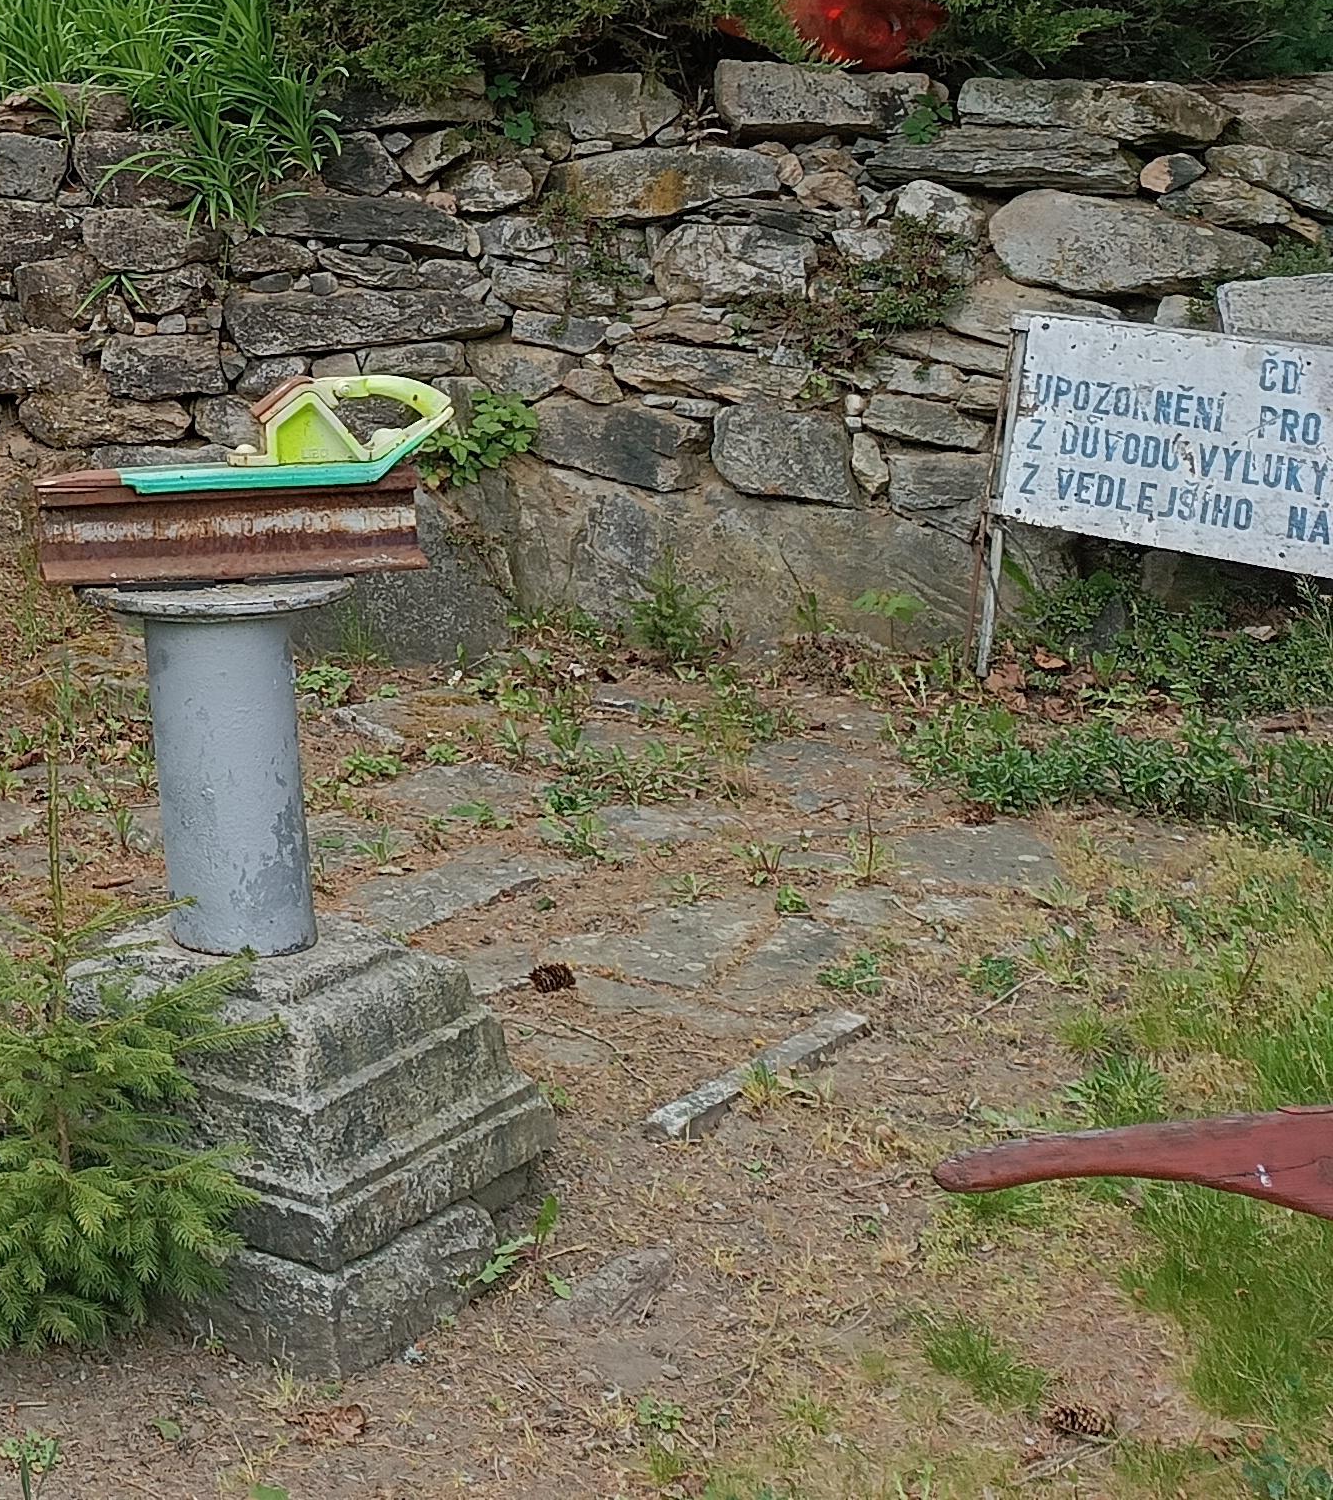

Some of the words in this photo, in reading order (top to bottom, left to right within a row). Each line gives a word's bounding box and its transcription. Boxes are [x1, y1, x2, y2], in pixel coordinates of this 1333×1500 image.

[1259, 350, 1301, 395] ČD
[1257, 405, 1322, 446] PRO
[1026, 419, 1047, 451] Z
[1199, 440, 1329, 496] VÝLUKY
[1019, 461, 1041, 495] Z
[1056, 467, 1253, 531] VEDLEJŠÍHO
